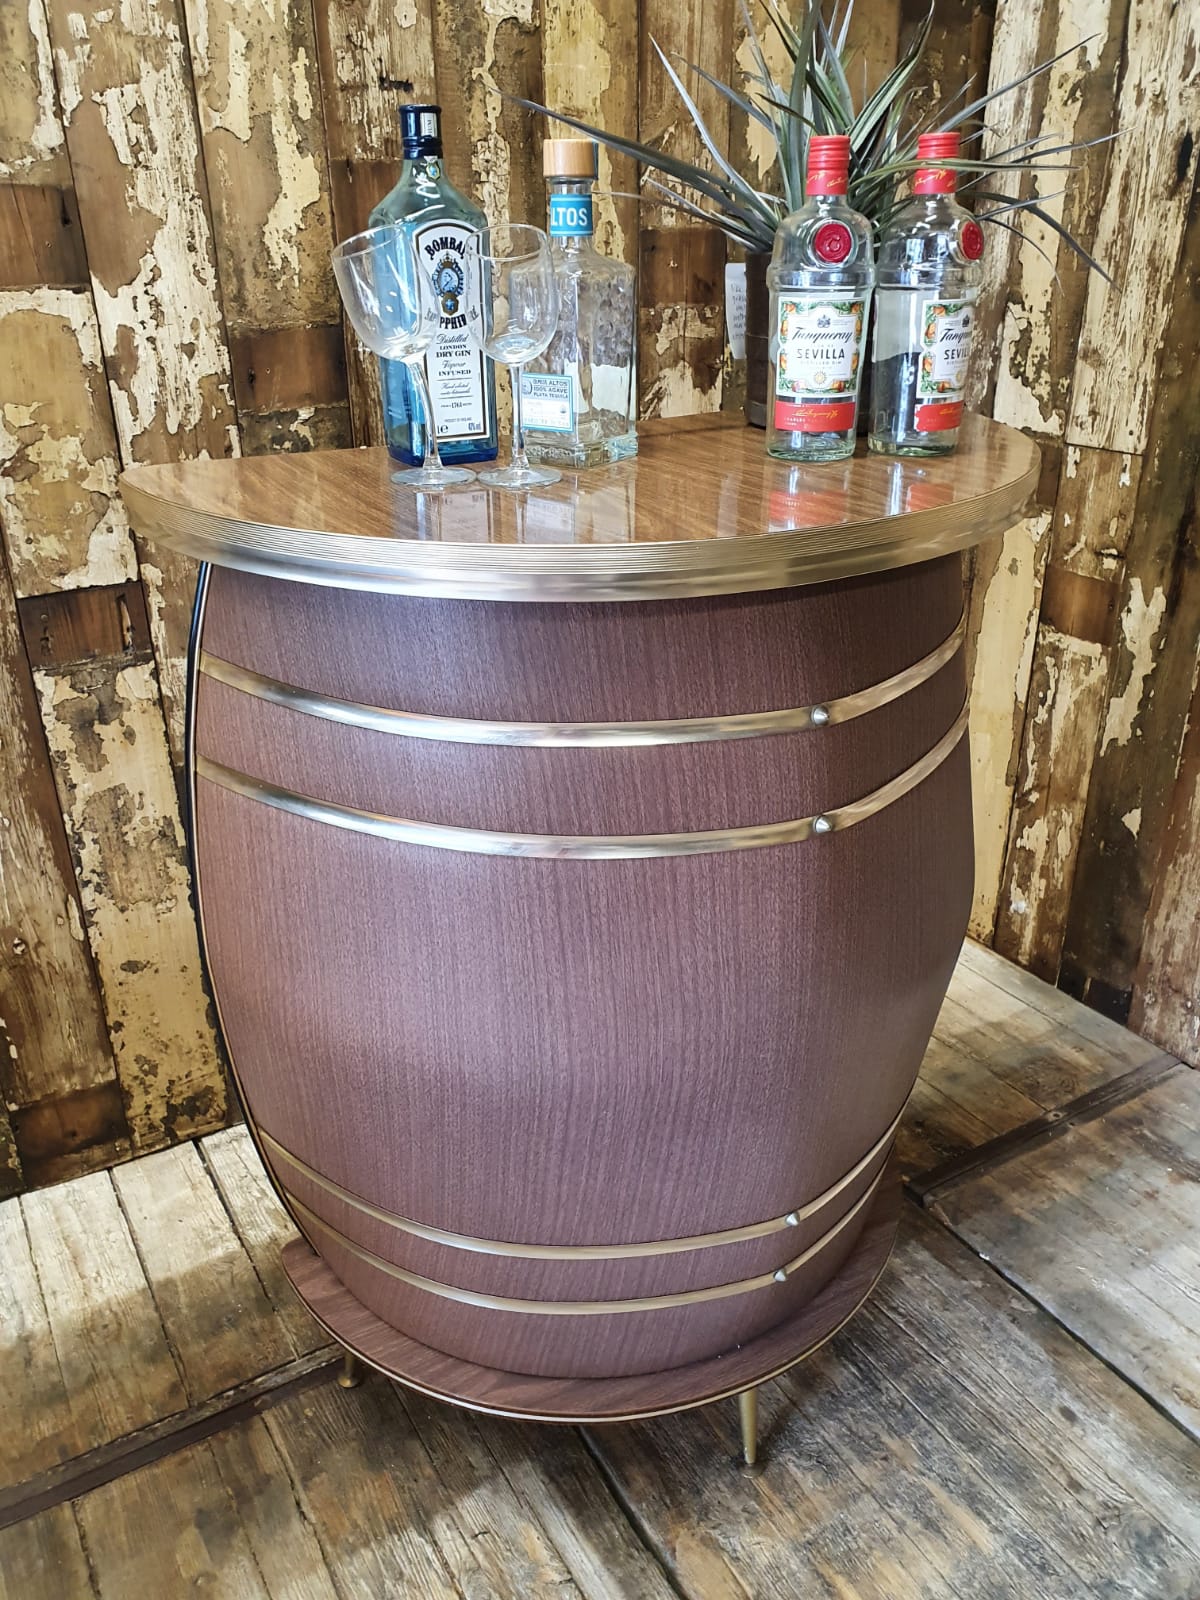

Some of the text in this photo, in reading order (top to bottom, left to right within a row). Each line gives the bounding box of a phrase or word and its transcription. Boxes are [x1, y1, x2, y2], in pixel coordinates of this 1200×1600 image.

[551, 207, 588, 226] LTOS
[424, 236, 467, 260] BOMBA
[792, 327, 853, 344] Tanqueray
[796, 348, 845, 360] SEVILLA
[438, 369, 471, 377] INFUSED
